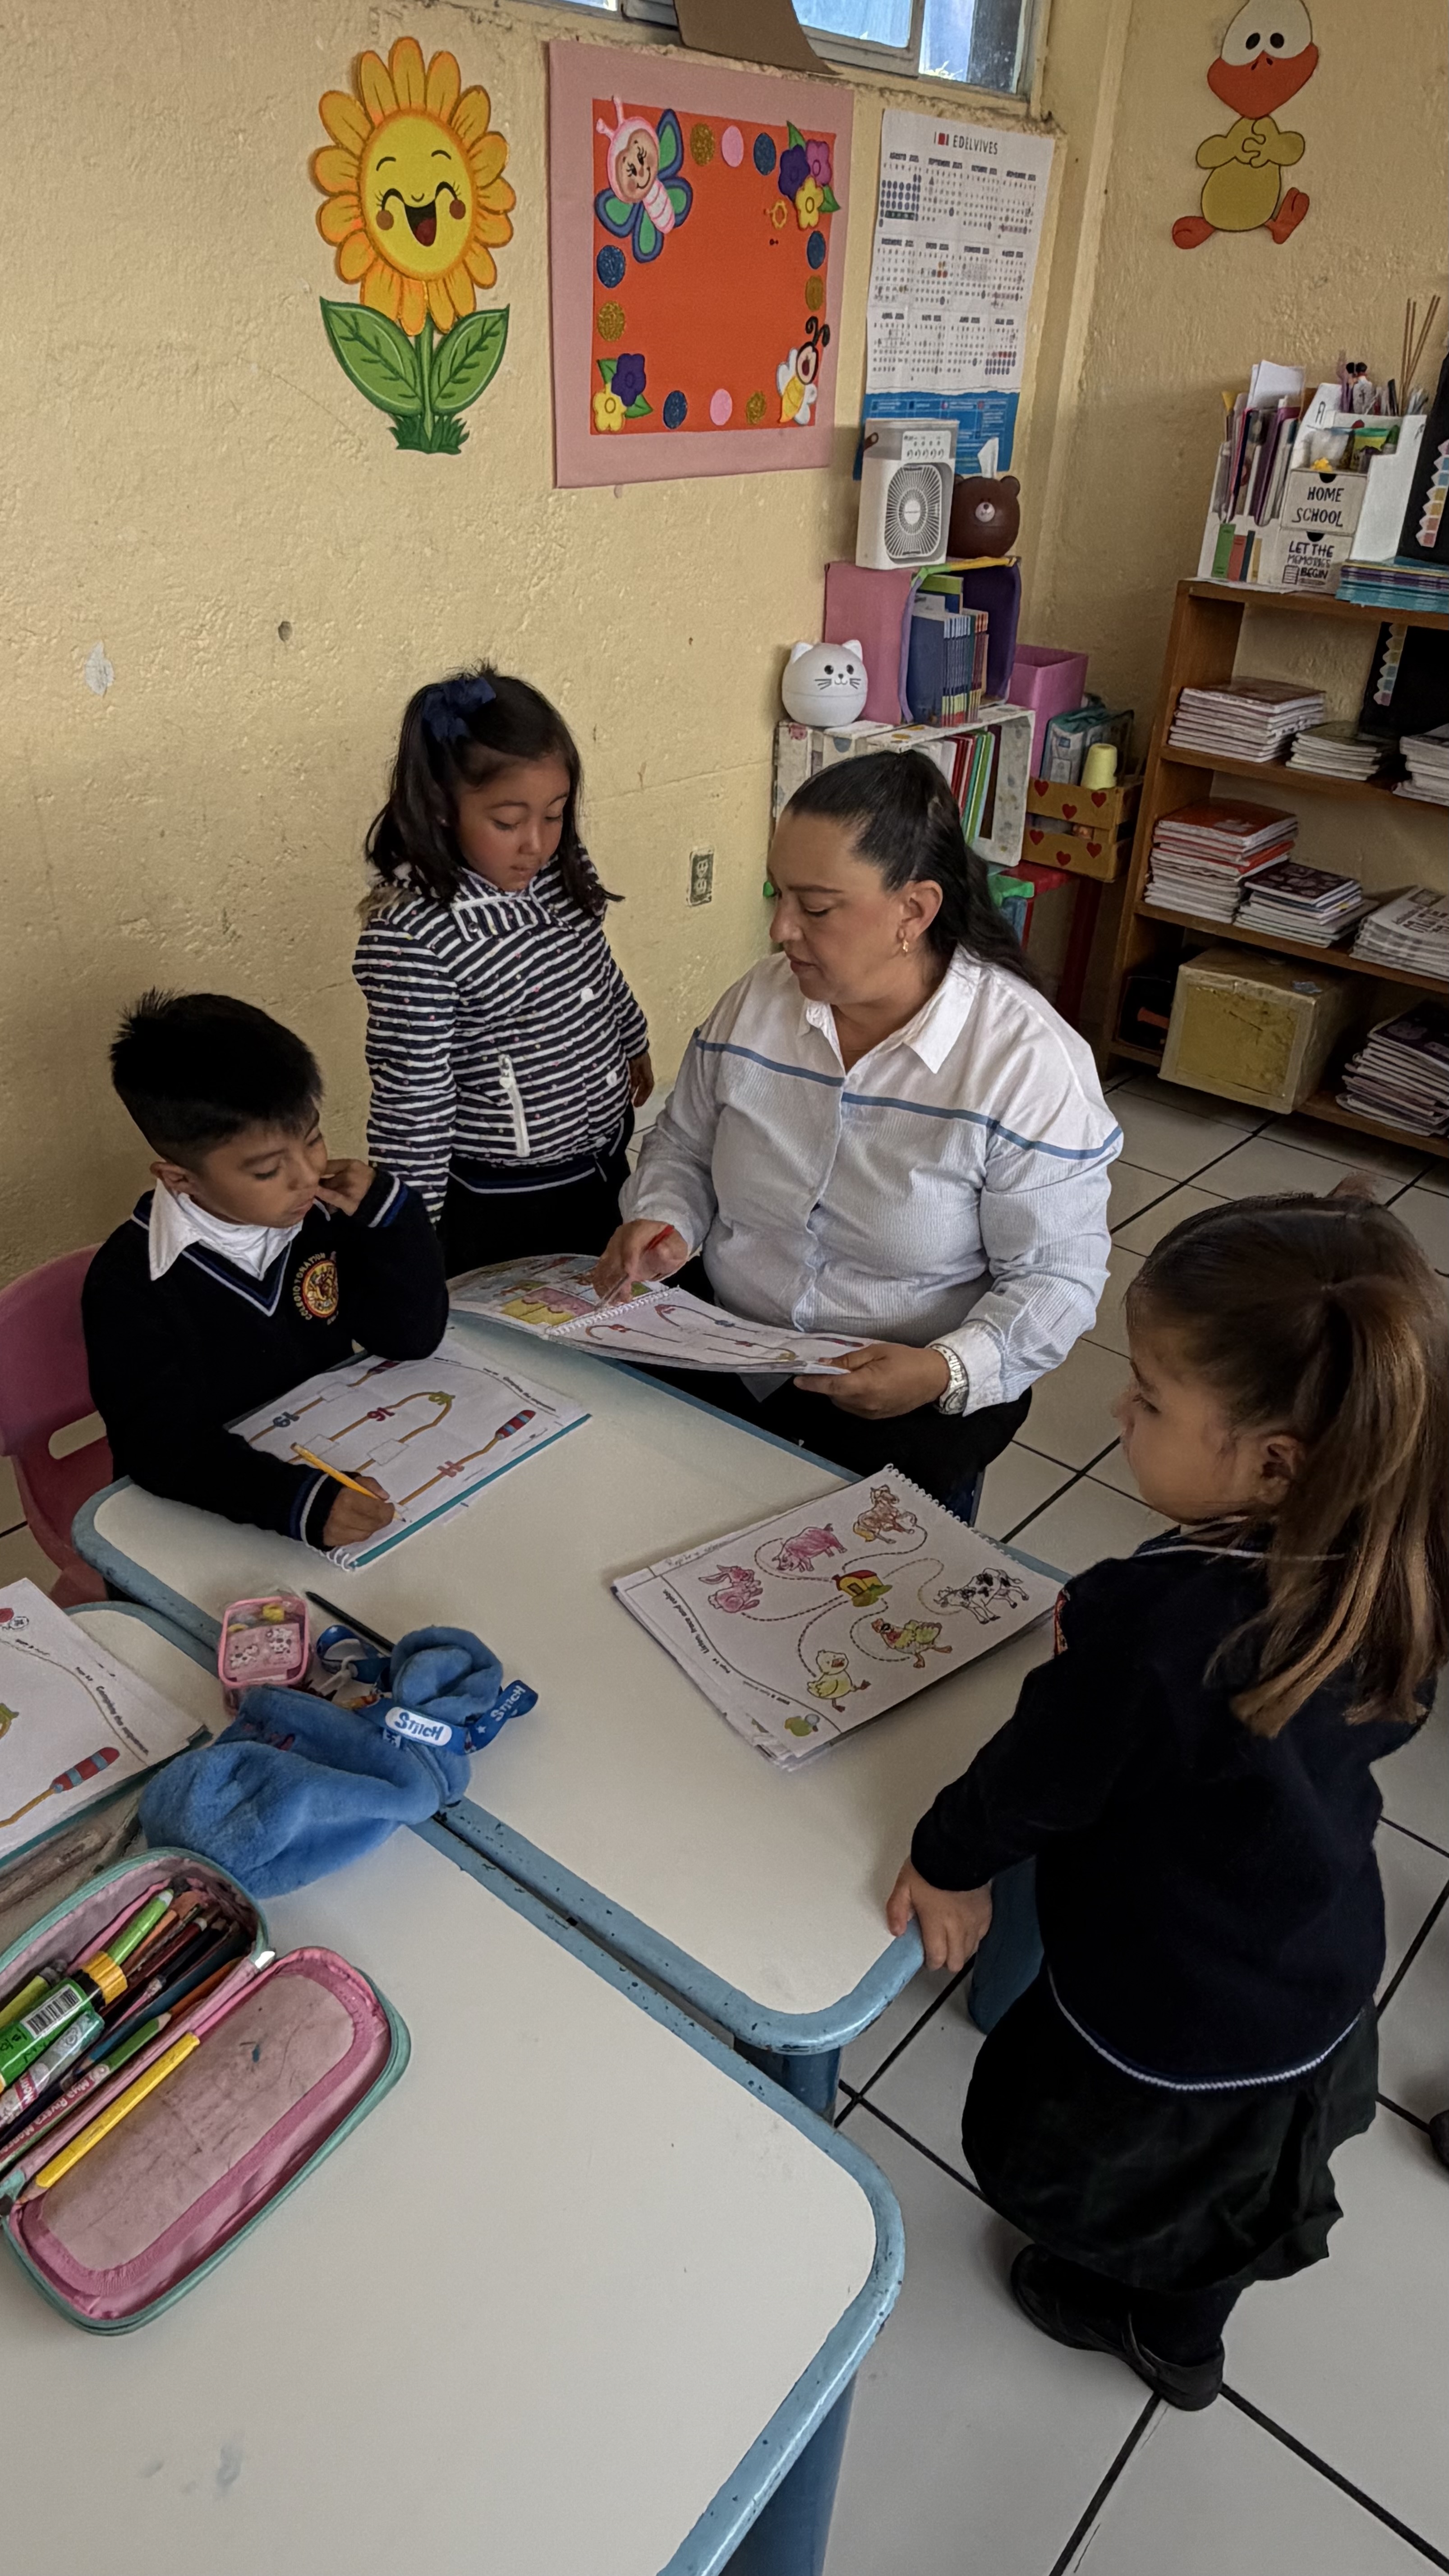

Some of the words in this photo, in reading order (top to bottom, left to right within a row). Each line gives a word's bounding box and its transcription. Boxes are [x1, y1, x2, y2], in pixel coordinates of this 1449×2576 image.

[952, 134, 998, 155] EDELVIVES
[1307, 486, 1345, 502] HOME
[1291, 507, 1343, 528] SCHOOL
[1289, 540, 1311, 554] LET
[1311, 543, 1335, 558] THE
[1287, 554, 1331, 568] MEMORIES
[1300, 567, 1329, 580] BEGIN
[272, 1411, 300, 1428] 19
[366, 1407, 396, 1422] 16
[673, 1604, 687, 1617] and
[67, 2078, 90, 2099] Mya
[35, 2097, 68, 2125] Rivera
